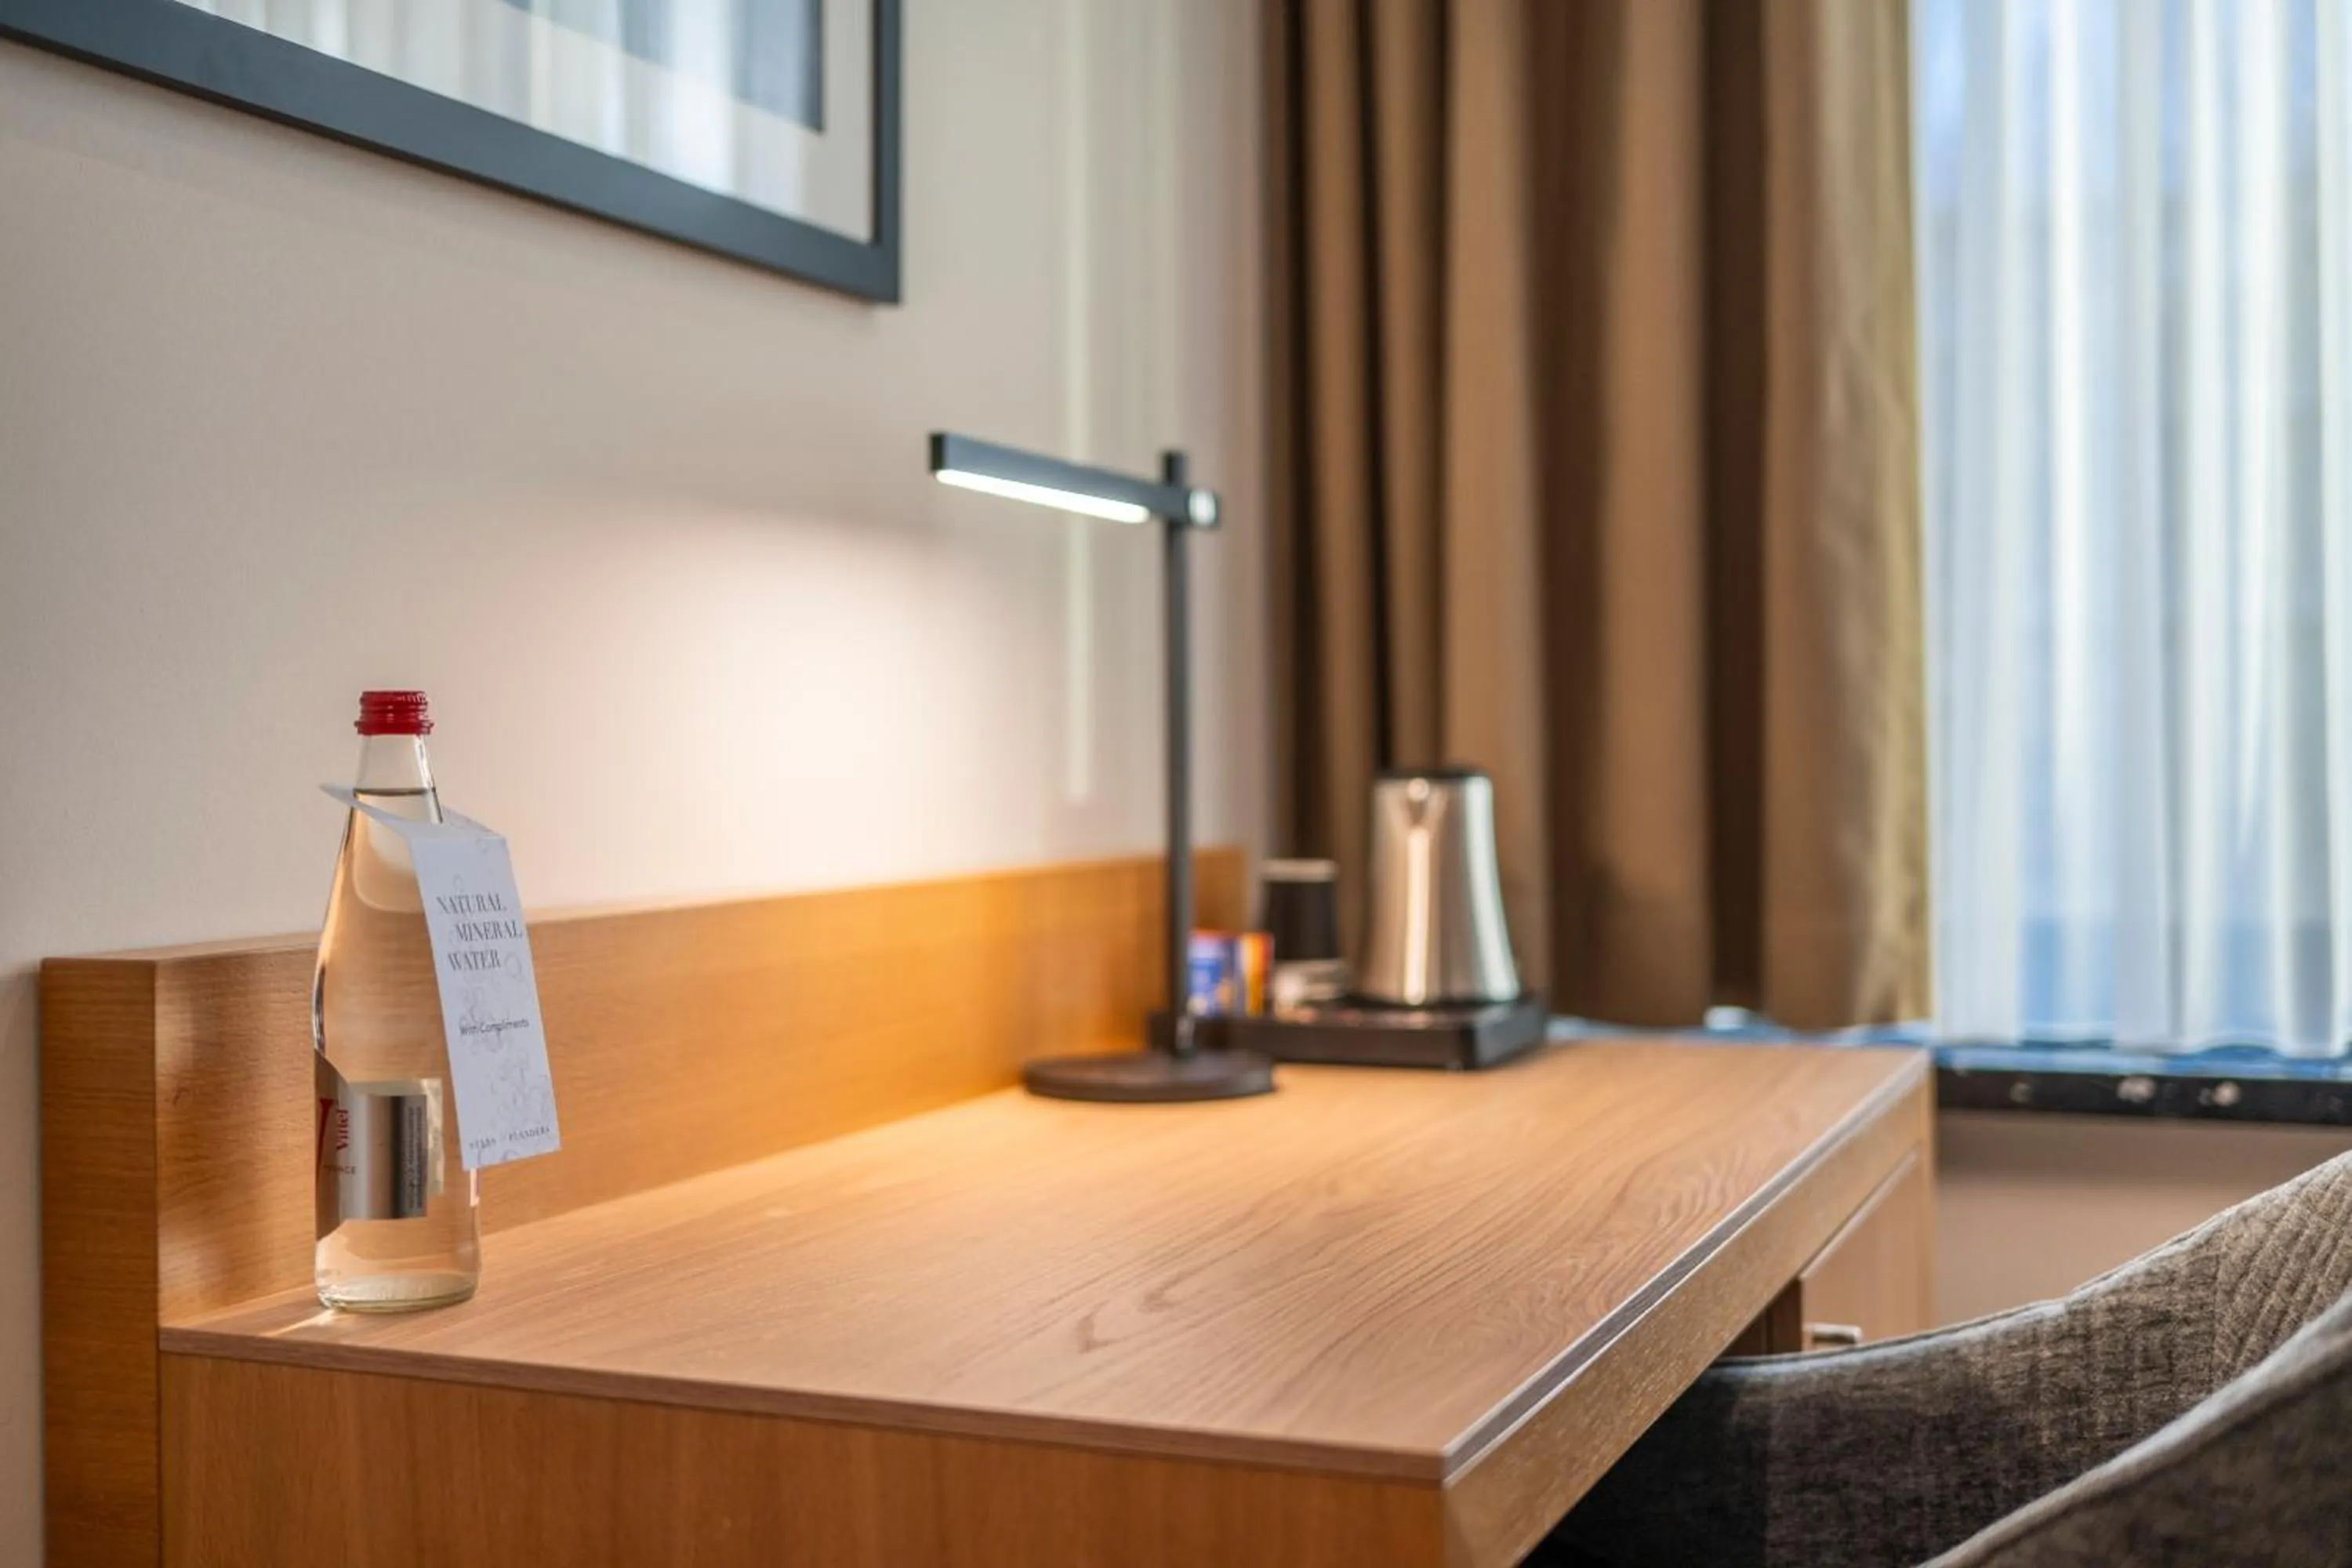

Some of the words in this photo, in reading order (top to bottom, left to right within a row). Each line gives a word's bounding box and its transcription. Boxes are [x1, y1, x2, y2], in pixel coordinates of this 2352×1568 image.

[436, 893, 506, 915] NATURAL
[454, 920, 523, 942] MINERAL
[448, 949, 502, 971] WATER
